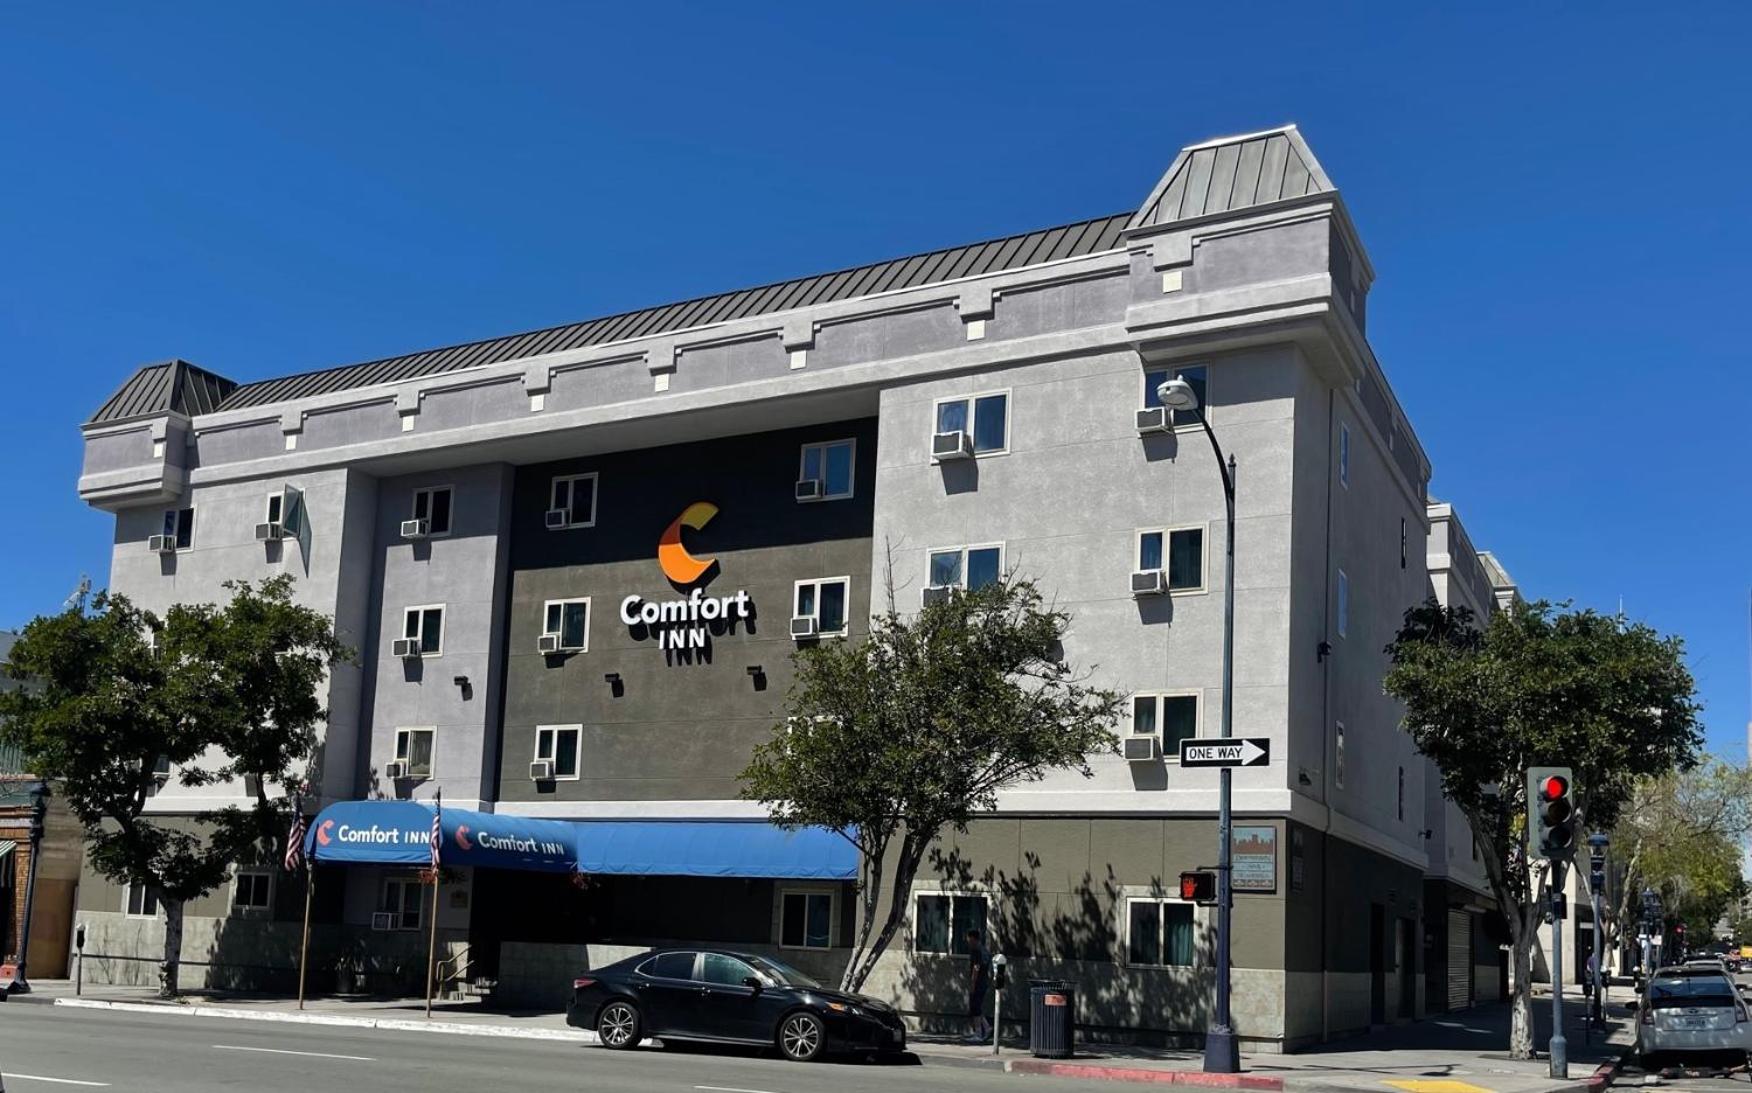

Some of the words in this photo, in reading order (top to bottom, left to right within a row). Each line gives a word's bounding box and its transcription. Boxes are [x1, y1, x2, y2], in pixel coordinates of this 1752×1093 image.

[620, 588, 749, 625] Comfort
[659, 628, 705, 649] INN
[1189, 748, 1213, 759] ONE
[1218, 747, 1242, 759] WAY
[338, 825, 399, 844] Comfort
[404, 831, 430, 844] INN
[478, 832, 538, 852] Comfort
[541, 842, 565, 855] INN
